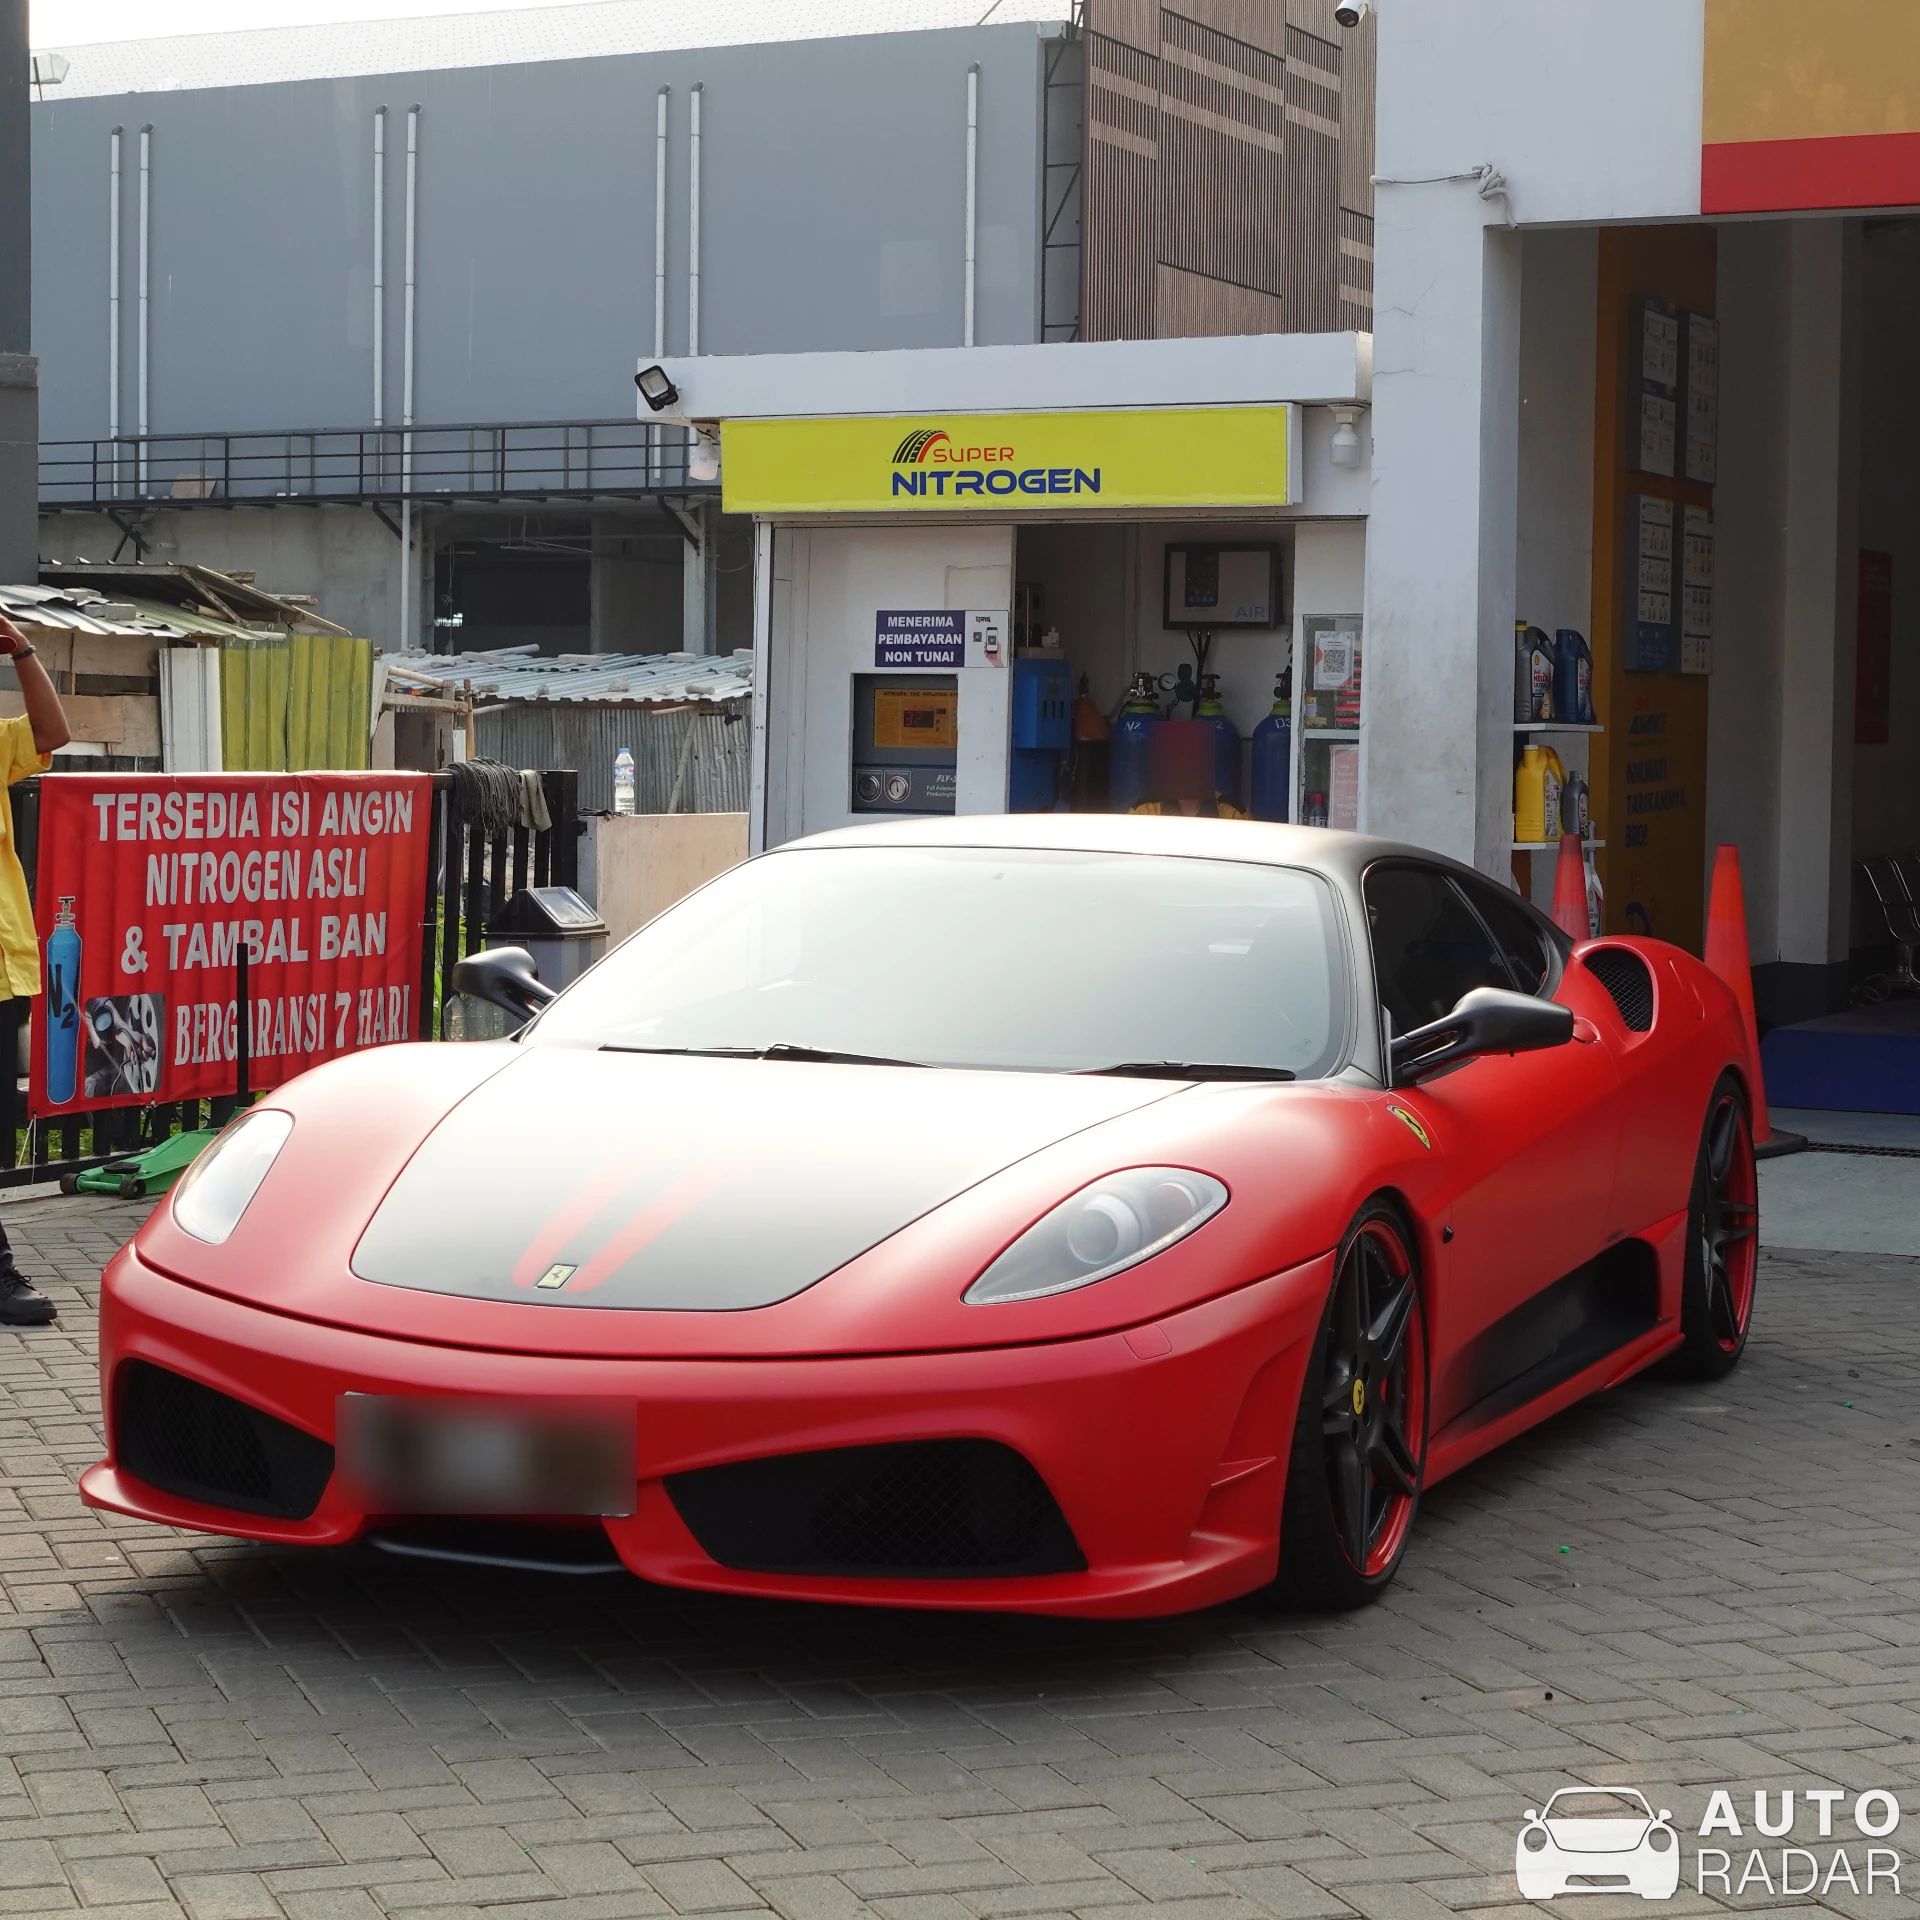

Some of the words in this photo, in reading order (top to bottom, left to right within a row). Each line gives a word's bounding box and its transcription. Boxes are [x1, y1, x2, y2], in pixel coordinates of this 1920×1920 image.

[933, 447, 1015, 463] SUPER
[892, 468, 1100, 496] NITROGEN
[887, 616, 954, 627] MENERIMA
[1235, 606, 1265, 618] AIR
[878, 633, 962, 645] PEMBAYARAN
[885, 651, 912, 662] NON
[916, 651, 954, 662] TUNAI
[1627, 758, 1667, 784] NIKMATI
[92, 793, 260, 841] TERSEDIA
[271, 791, 310, 837] ISI
[319, 790, 414, 836] ANGIN
[1626, 823, 1648, 848] BRO!
[146, 850, 301, 906] NITROGEN
[307, 848, 367, 899] ASLI
[121, 925, 150, 975] &
[163, 918, 309, 971] TAMBAL
[320, 912, 387, 961] BAN
[333, 991, 352, 1049] 7
[357, 985, 410, 1046] HARI
